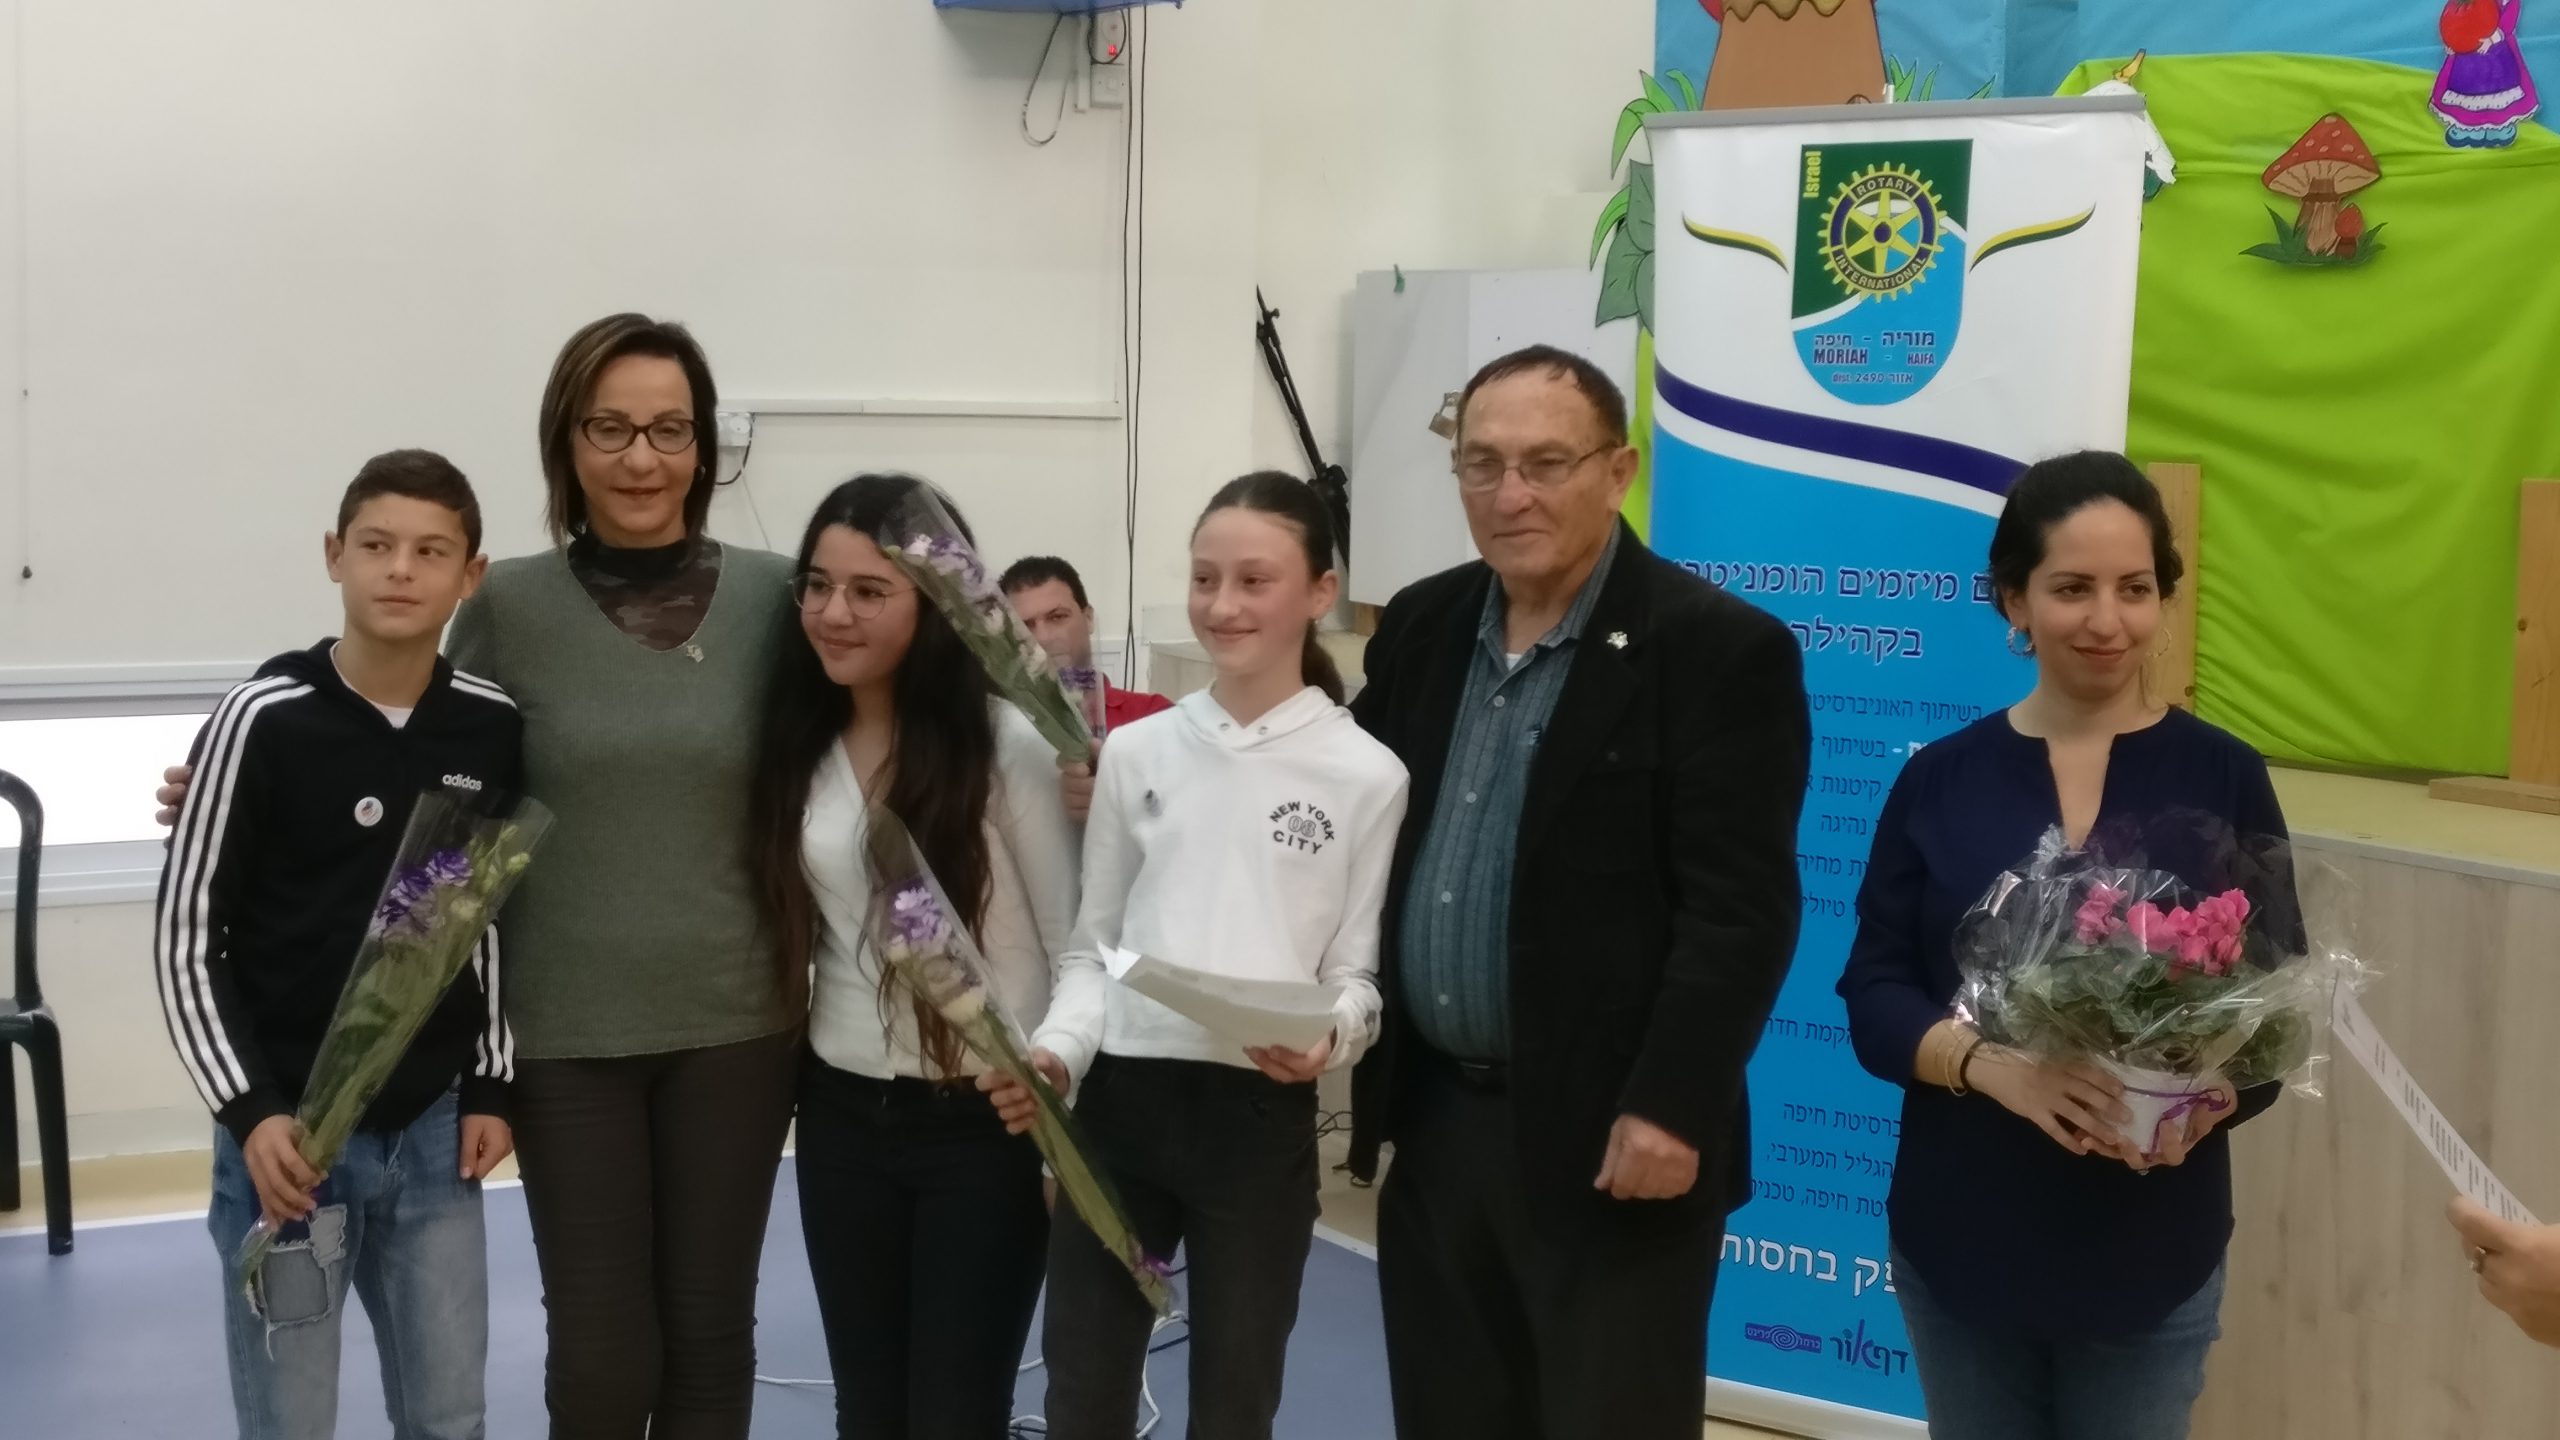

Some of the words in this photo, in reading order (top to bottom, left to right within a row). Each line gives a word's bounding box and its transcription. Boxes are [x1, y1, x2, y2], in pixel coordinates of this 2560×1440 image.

[1803, 151, 1822, 198] Israel
[1856, 177, 1914, 196] ROTARY
[1835, 254, 1926, 290] INTERNATIONAL
[1814, 334, 1853, 346] חיפה
[1882, 331, 1935, 346] מוריה
[1813, 348, 1868, 365] MORIAH
[1907, 353, 1935, 366] HAIFA
[1855, 372, 1885, 384] 2490
[1838, 565, 1960, 602] מיזמים
[1920, 700, 1983, 726] בשיתוף
[1820, 735, 1887, 760] בשיתוף
[442, 773, 483, 791] adidas
[1820, 775, 1882, 803] קיטנות
[1269, 801, 1301, 823] NEW
[1307, 803, 1335, 840] YORK
[1821, 814, 1867, 836] נהיגה
[1273, 830, 1323, 855] CITY
[1783, 1103, 1827, 1124] חיפה
[1845, 1150, 1895, 1179] הגליל
[1720, 1233, 1839, 1282] בחסות
